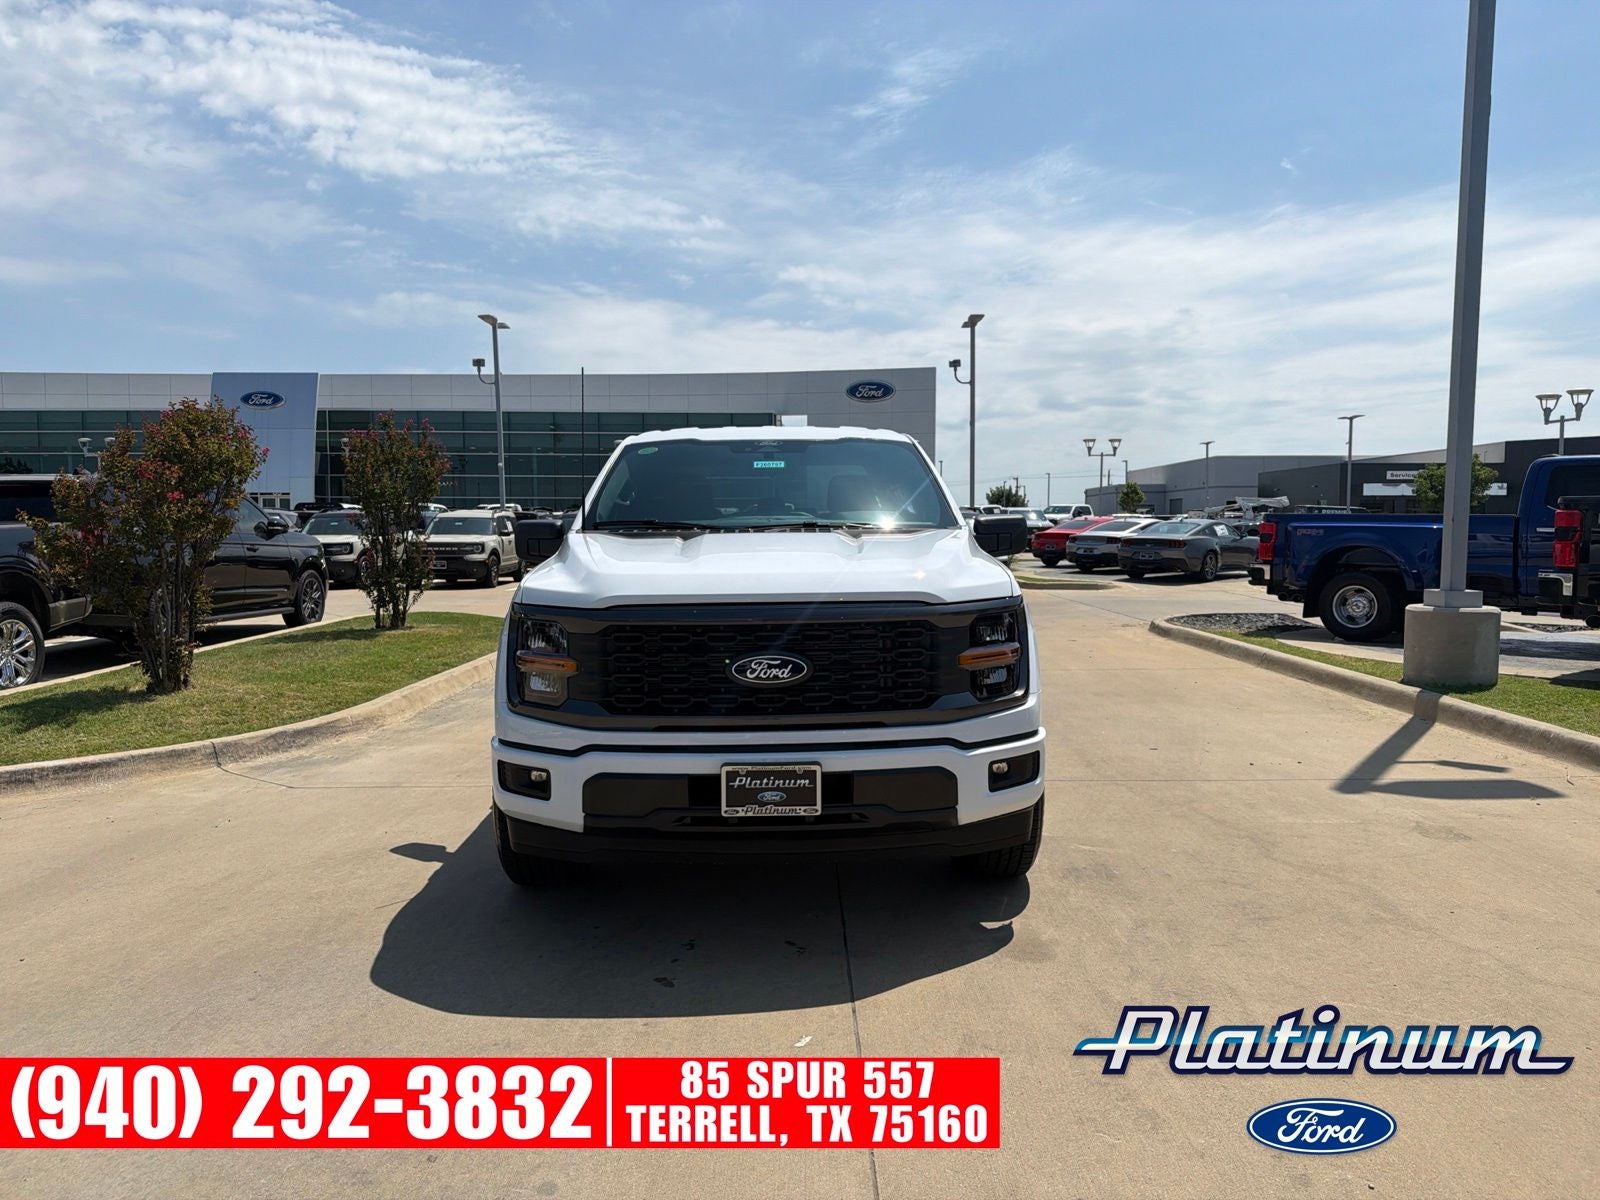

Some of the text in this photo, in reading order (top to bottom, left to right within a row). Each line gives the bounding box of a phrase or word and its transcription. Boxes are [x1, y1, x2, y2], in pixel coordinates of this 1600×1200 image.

[856, 384, 884, 397] Ford
[248, 393, 274, 405] Ford
[746, 659, 793, 679] Ford
[728, 776, 815, 789] Platinum
